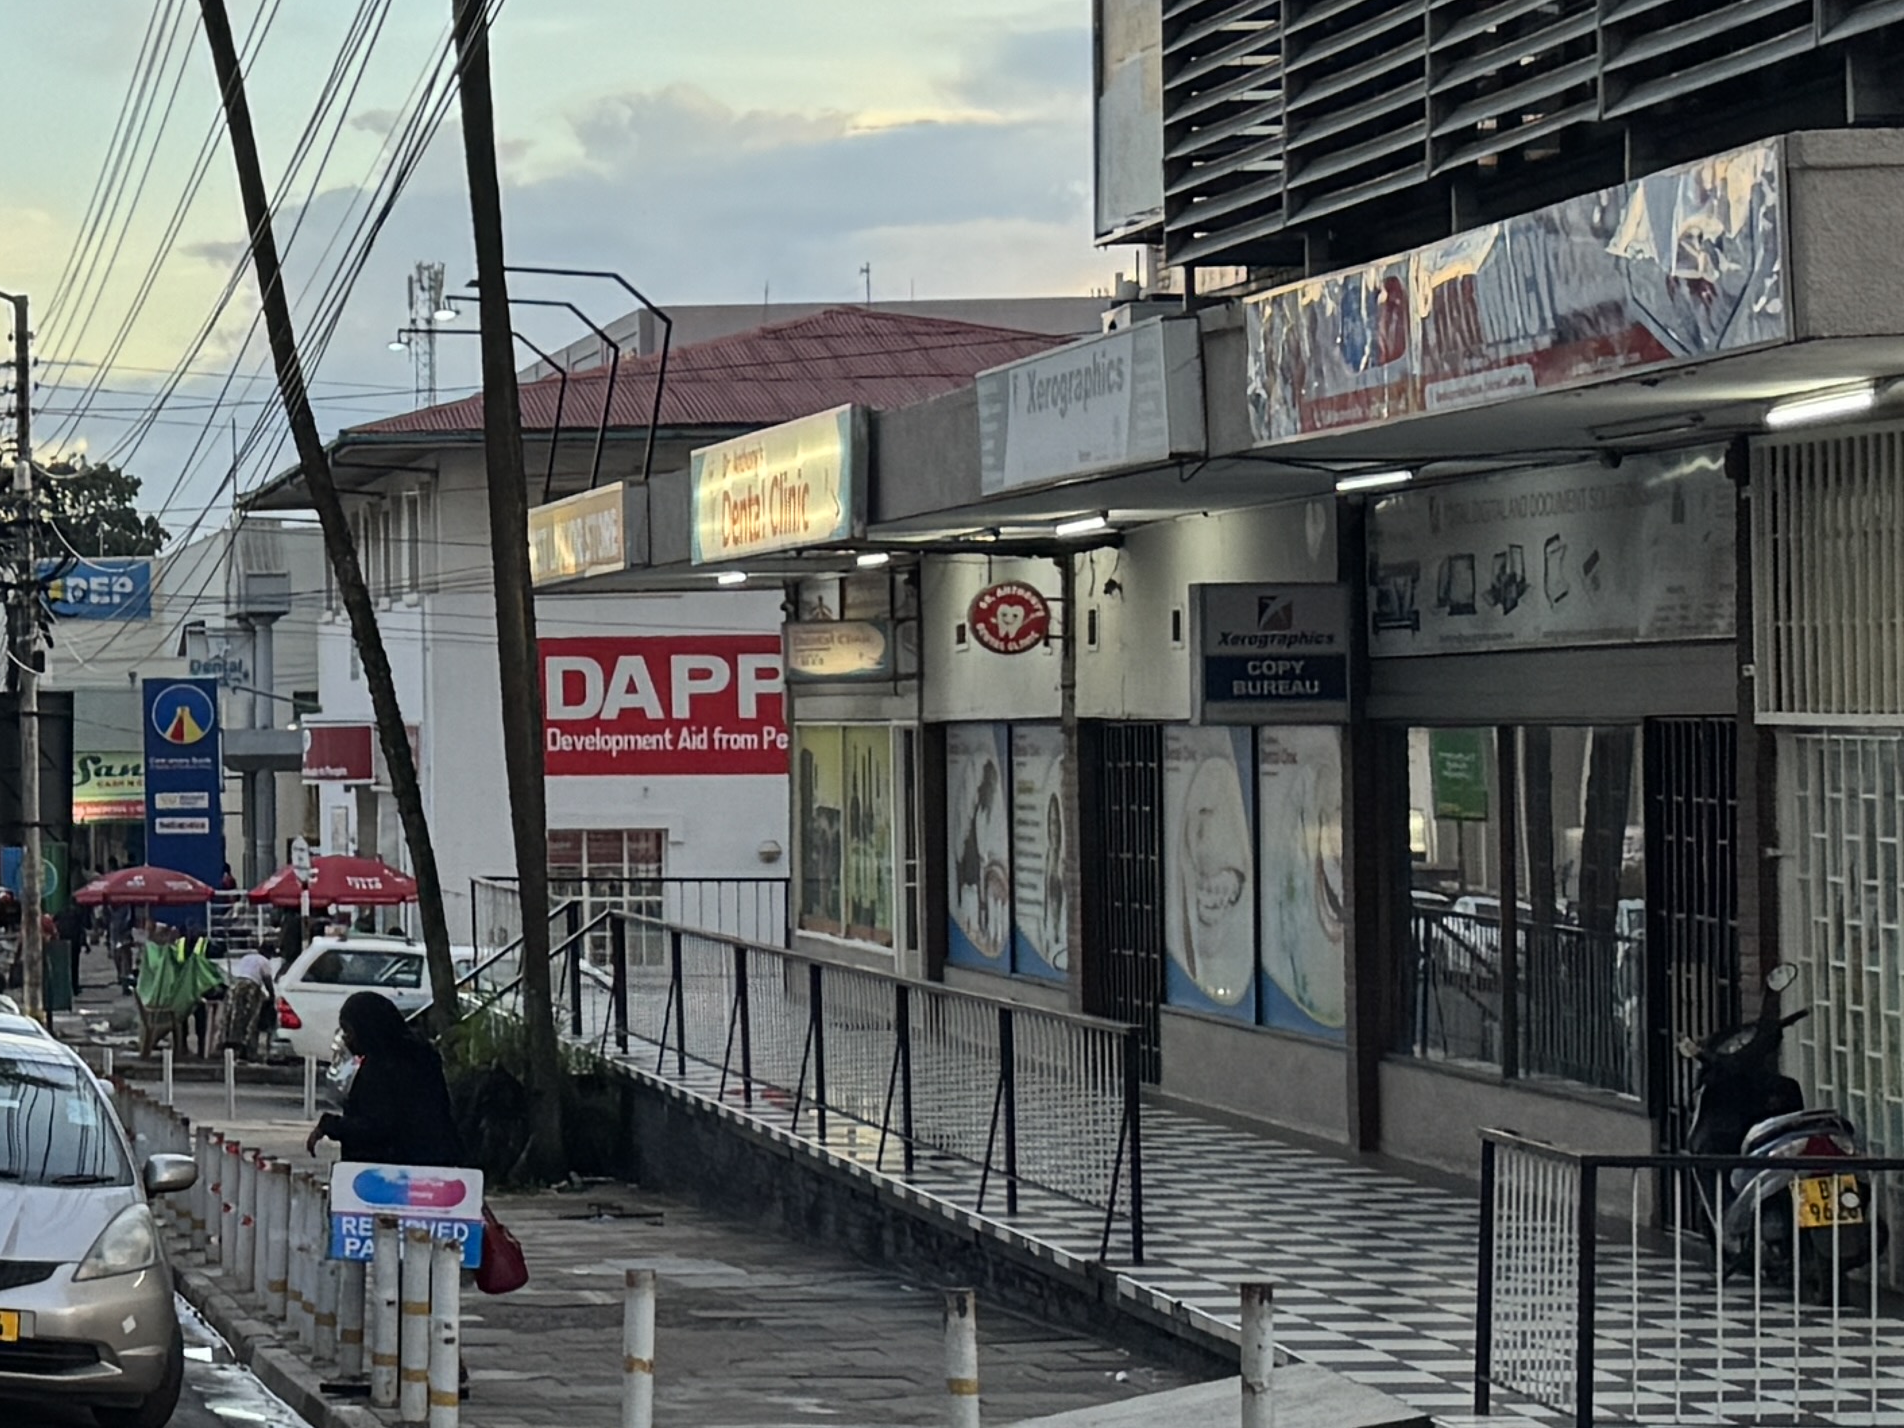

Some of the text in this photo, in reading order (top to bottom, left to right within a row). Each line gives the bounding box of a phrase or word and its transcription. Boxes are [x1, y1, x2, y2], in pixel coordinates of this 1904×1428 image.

[1026, 348, 1124, 419] Xerographics
[722, 468, 810, 548] Dental Clinic
[1218, 631, 1335, 649] Xerographics
[1247, 660, 1304, 676] COPY
[545, 653, 785, 720] DAPP
[1232, 679, 1320, 696] BUREAU
[546, 727, 673, 757] Development
[678, 727, 708, 750] Aid
[713, 726, 758, 750] from
